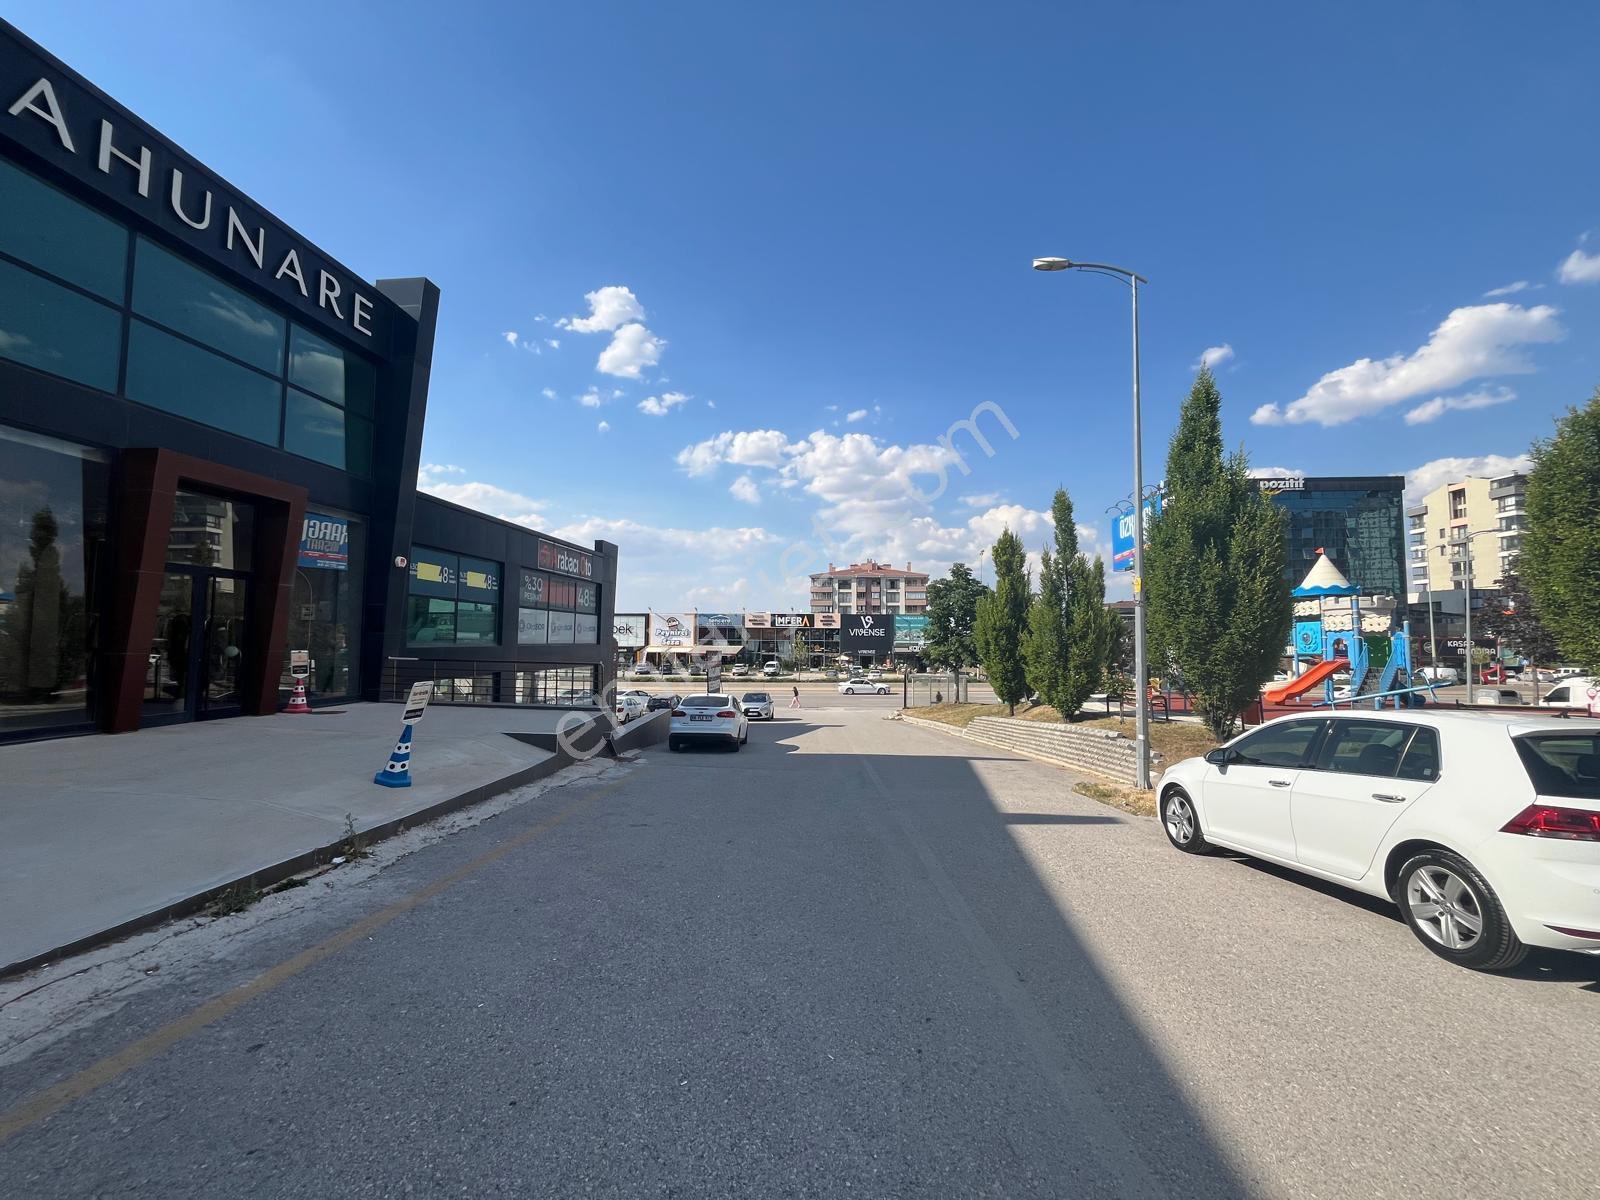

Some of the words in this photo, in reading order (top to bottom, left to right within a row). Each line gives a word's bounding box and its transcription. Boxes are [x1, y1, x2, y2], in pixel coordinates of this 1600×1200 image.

[8, 77, 375, 337] AHUNARE
[1259, 477, 1304, 490] pozitif
[524, 575, 543, 592] %30
[577, 588, 590, 606] 48
[655, 629, 689, 637] Peynirci
[848, 628, 885, 636] VIVENSE
